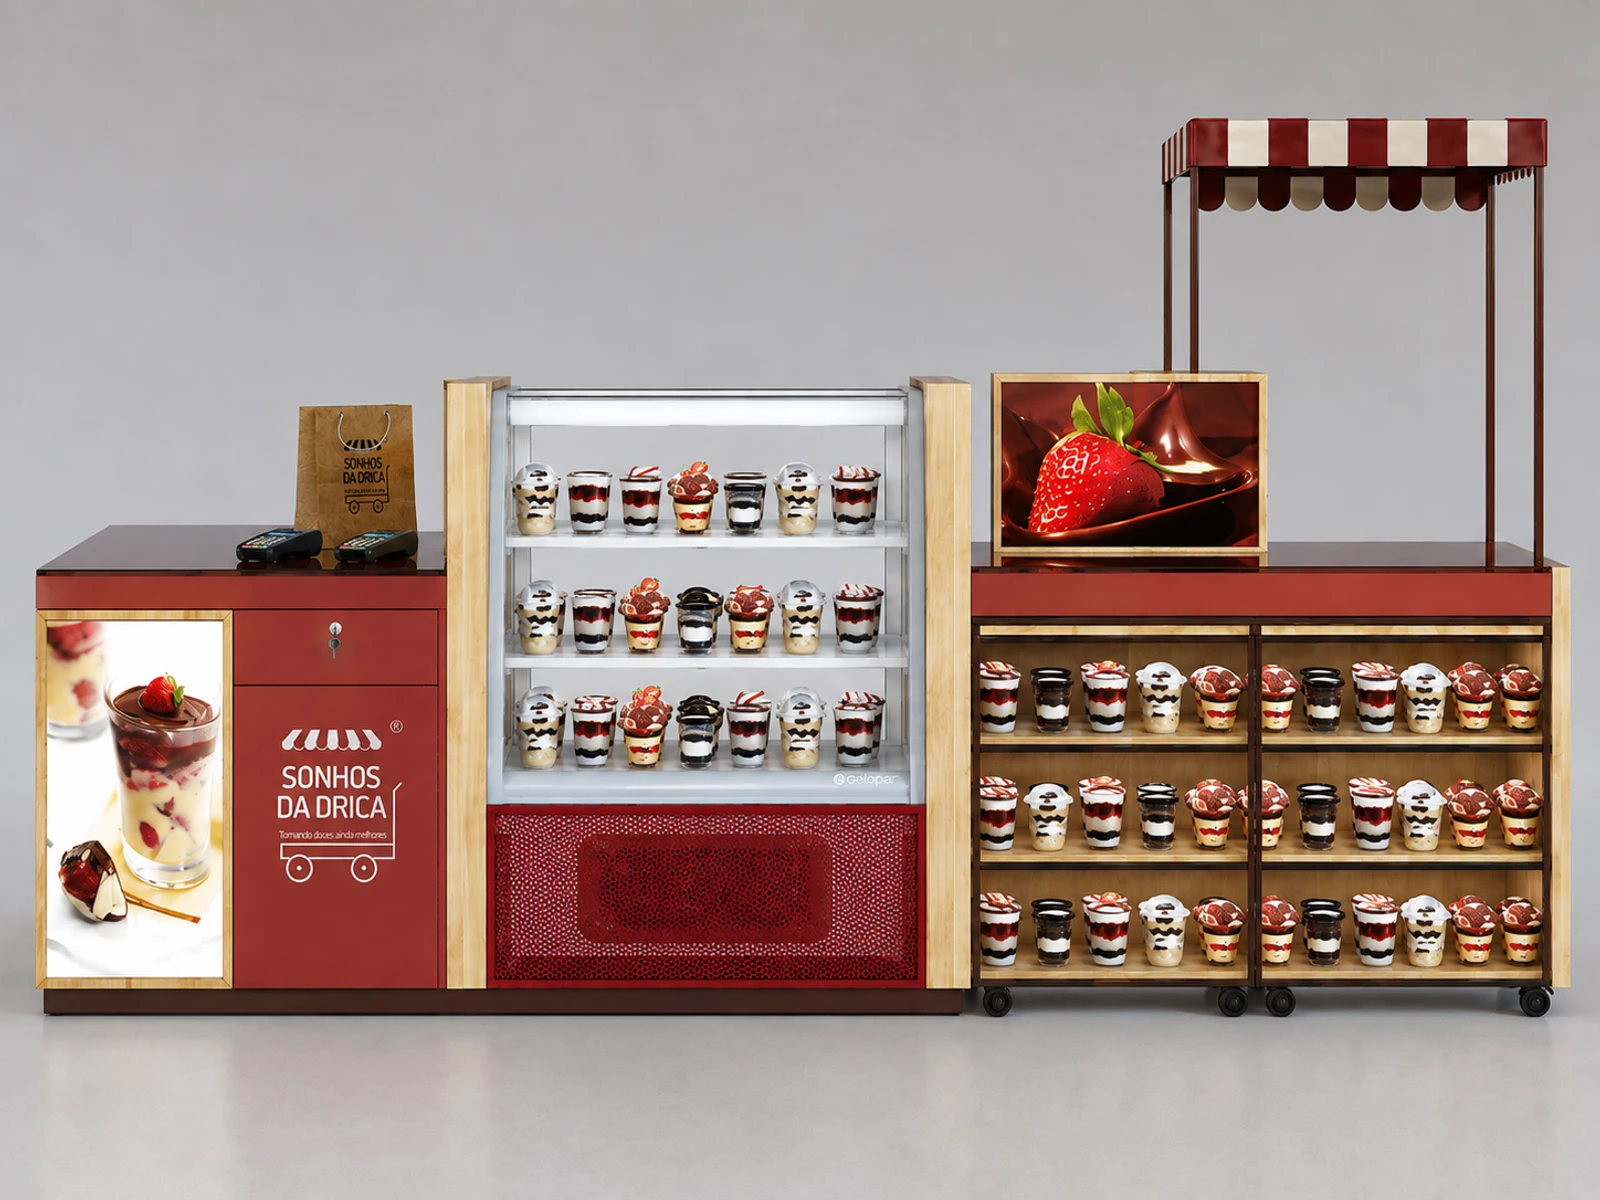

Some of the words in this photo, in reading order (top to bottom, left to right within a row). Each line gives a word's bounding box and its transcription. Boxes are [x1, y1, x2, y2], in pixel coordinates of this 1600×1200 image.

[343, 456, 383, 470] SONHOS
[343, 471, 357, 484] DA
[358, 471, 385, 484] DRICA
[281, 765, 381, 789] SONHOS
[277, 795, 310, 819] DA
[316, 795, 387, 819] DRICA
